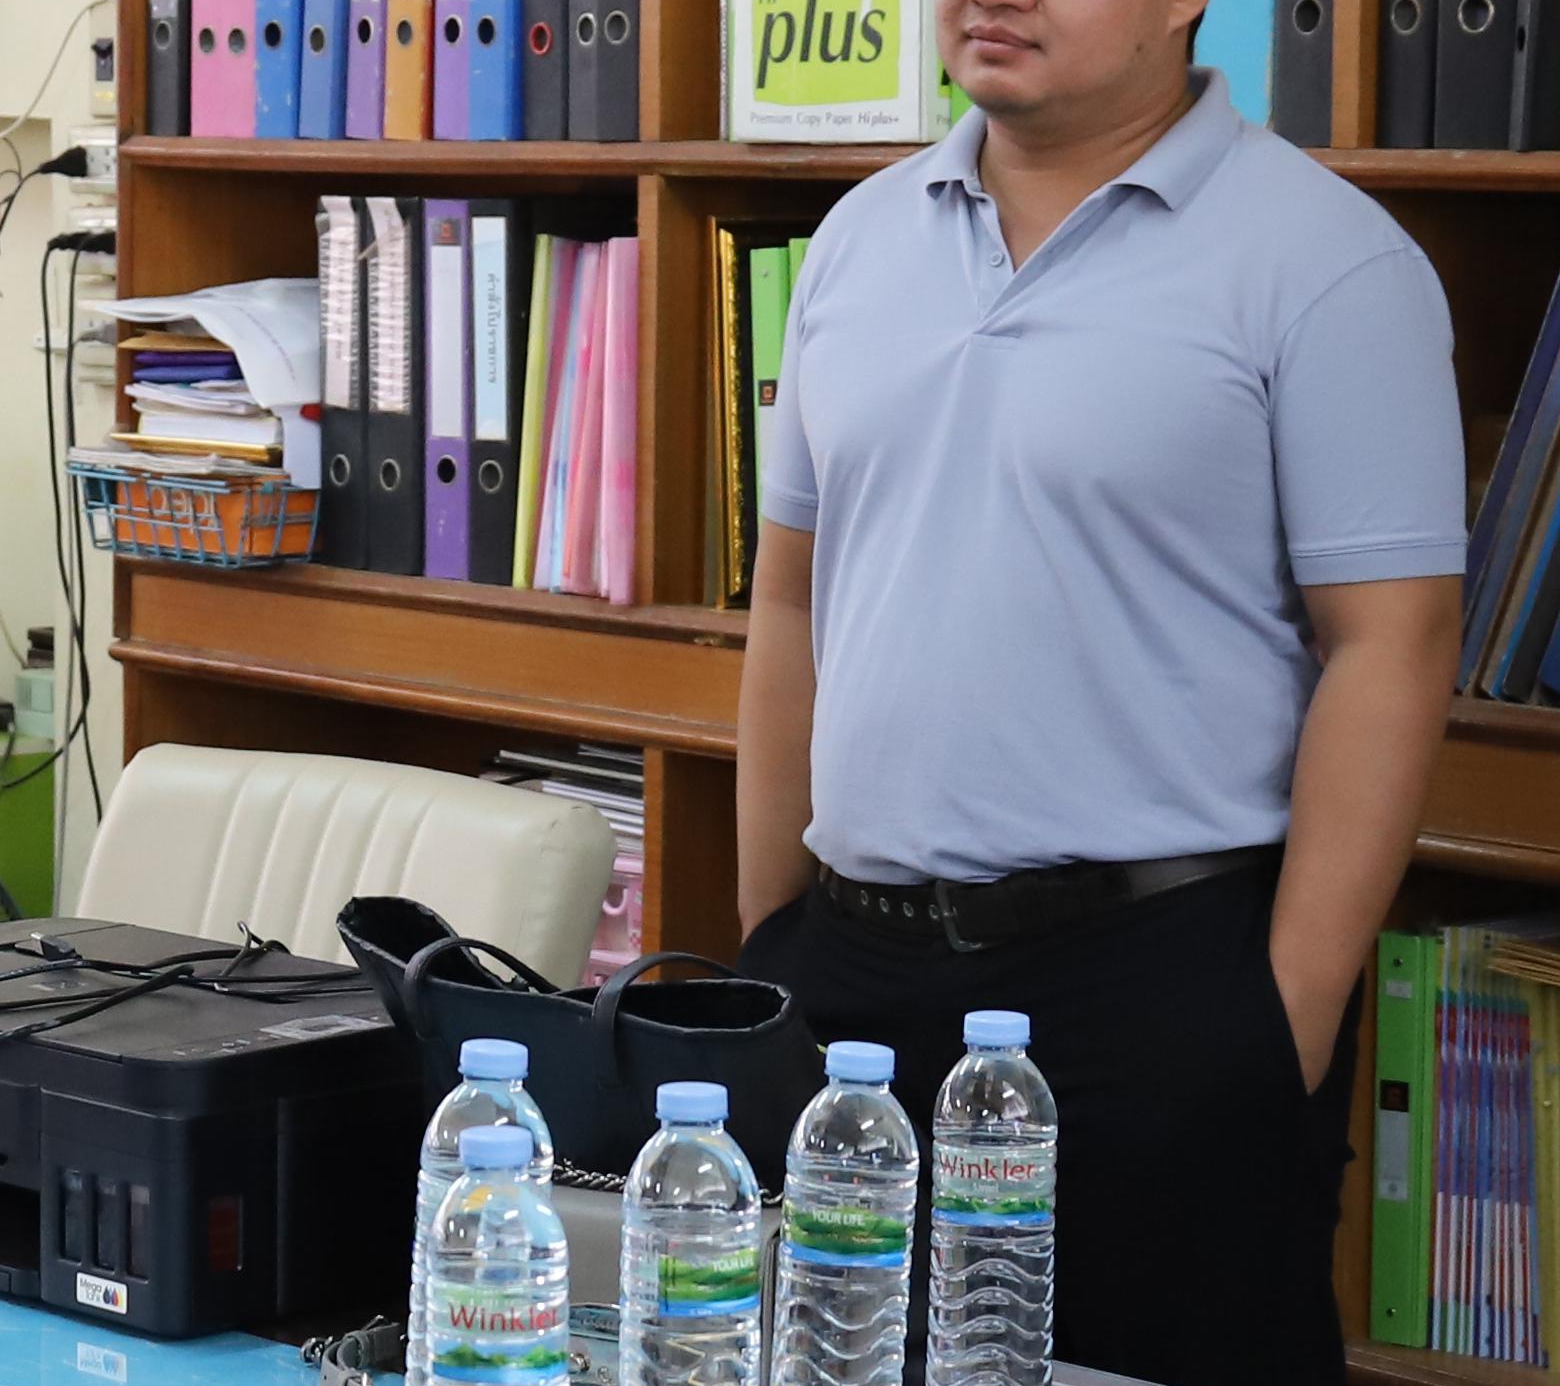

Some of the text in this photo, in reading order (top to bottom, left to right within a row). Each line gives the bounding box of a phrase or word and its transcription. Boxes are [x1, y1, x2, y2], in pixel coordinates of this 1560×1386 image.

[750, 113, 792, 123] Premium
[796, 113, 821, 127] Copy
[825, 113, 854, 125] Paper
[939, 1152, 1036, 1180] Winkler
[812, 1209, 865, 1226] YOUR LIFE
[712, 1259, 738, 1271] YOUR
[80, 1278, 102, 1292] Mega
[448, 1302, 558, 1332] Winkler
